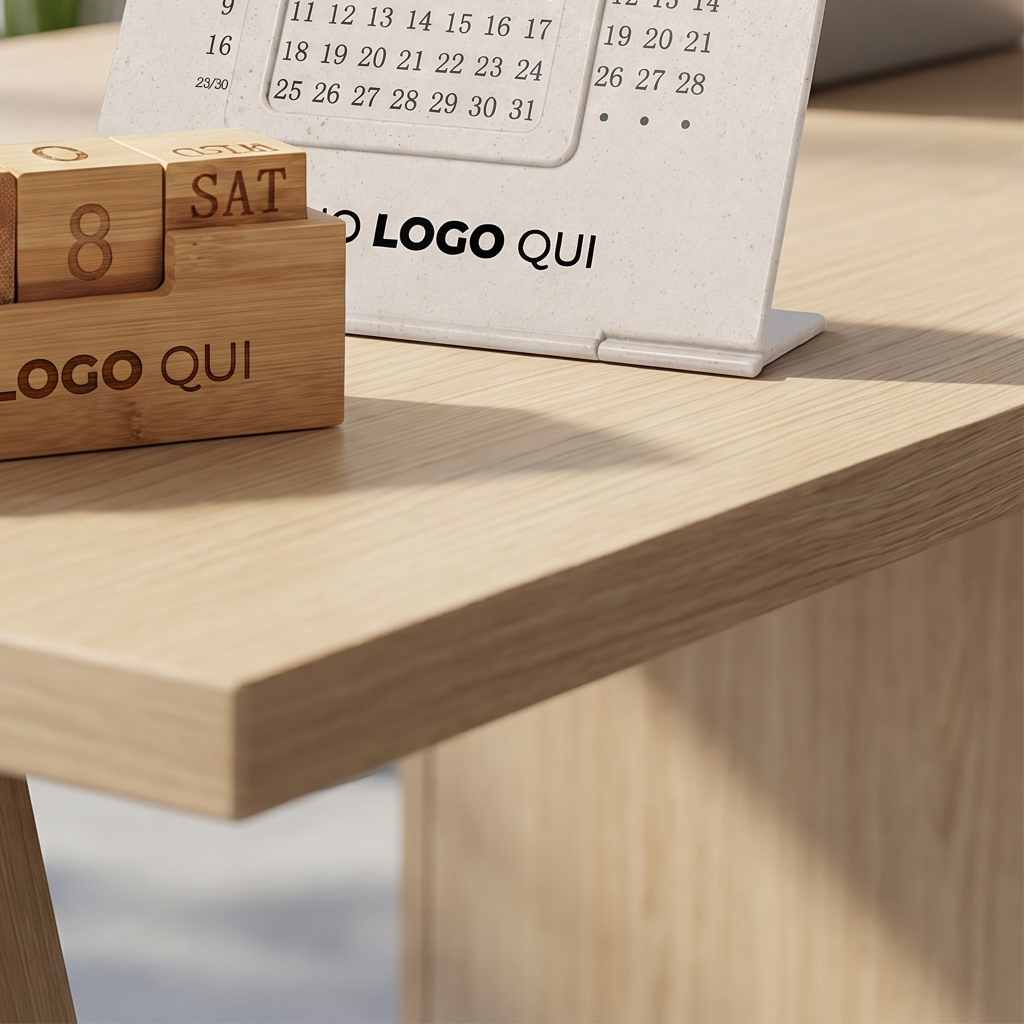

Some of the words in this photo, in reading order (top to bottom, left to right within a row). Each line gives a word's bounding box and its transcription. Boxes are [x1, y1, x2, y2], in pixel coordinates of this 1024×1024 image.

[290, 0, 315, 24] 11
[328, 3, 356, 26] 12
[367, 6, 394, 28] 13
[406, 9, 432, 32] 14
[445, 12, 473, 34] 15
[484, 15, 512, 37] 16
[524, 18, 553, 41] 17
[603, 24, 631, 48] 19
[642, 27, 673, 50] 20
[683, 30, 711, 54] 21
[205, 34, 233, 56] 16
[281, 39, 309, 63] 18
[320, 43, 348, 65] 19
[357, 46, 387, 69] 20
[396, 49, 423, 71] 21
[434, 52, 465, 75] 22
[474, 55, 503, 78] 23
[514, 59, 543, 82] 24
[194, 76, 229, 91] 23/30
[273, 78, 303, 101] 25
[311, 81, 341, 105] 26
[350, 85, 381, 108] 27
[389, 88, 419, 112] 28
[428, 91, 458, 114] 29
[468, 95, 497, 118] 30
[508, 98, 534, 121] 31
[593, 65, 624, 88] 26
[634, 68, 666, 91] 27
[675, 71, 706, 96] 28
[190, 166, 287, 219] SAT
[67, 202, 113, 282] 8
[372, 212, 505, 259] LOGO
[517, 229, 597, 271] QUI
[160, 340, 251, 394] QUI
